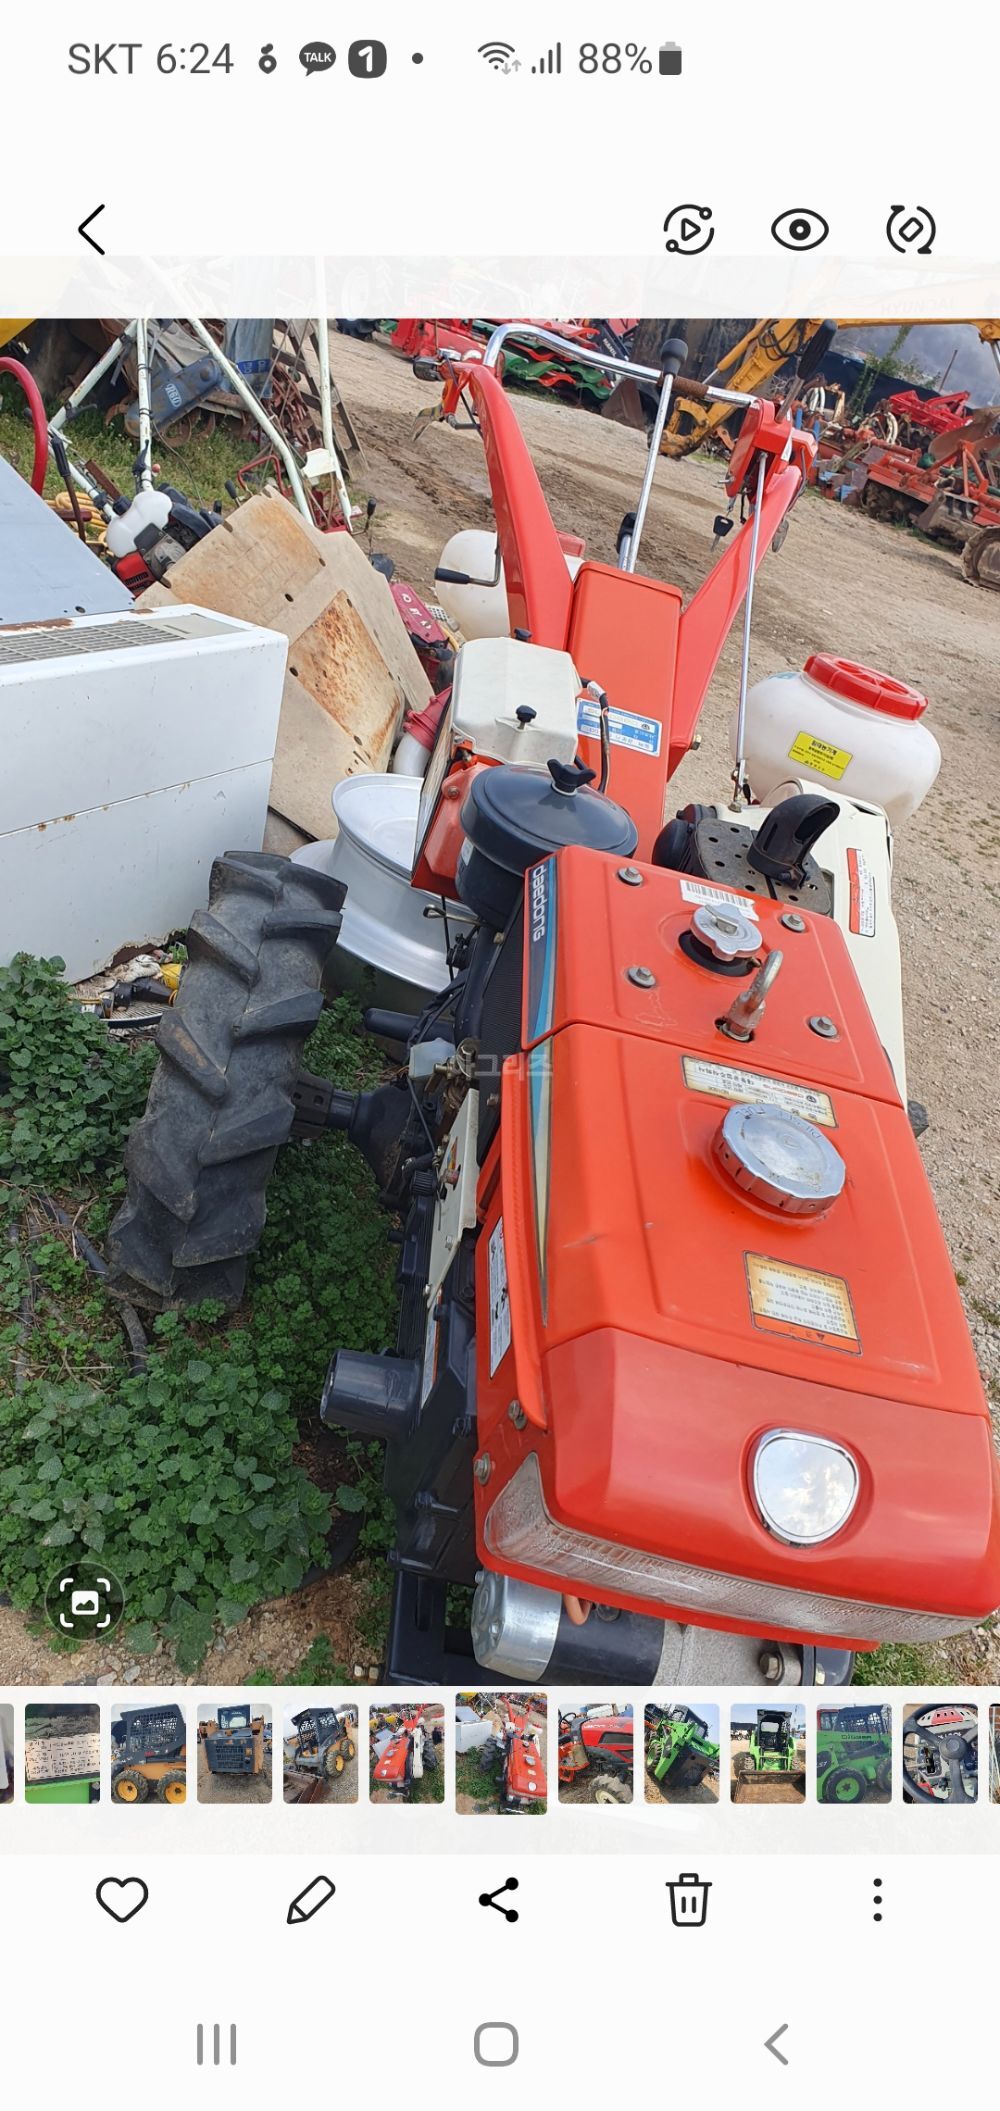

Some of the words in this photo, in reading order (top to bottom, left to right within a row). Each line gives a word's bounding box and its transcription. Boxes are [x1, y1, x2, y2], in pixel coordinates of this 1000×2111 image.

[67, 42, 143, 75] SKT
[156, 42, 235, 75] 6:24
[303, 52, 332, 64] TALK
[578, 42, 653, 75] 88%
